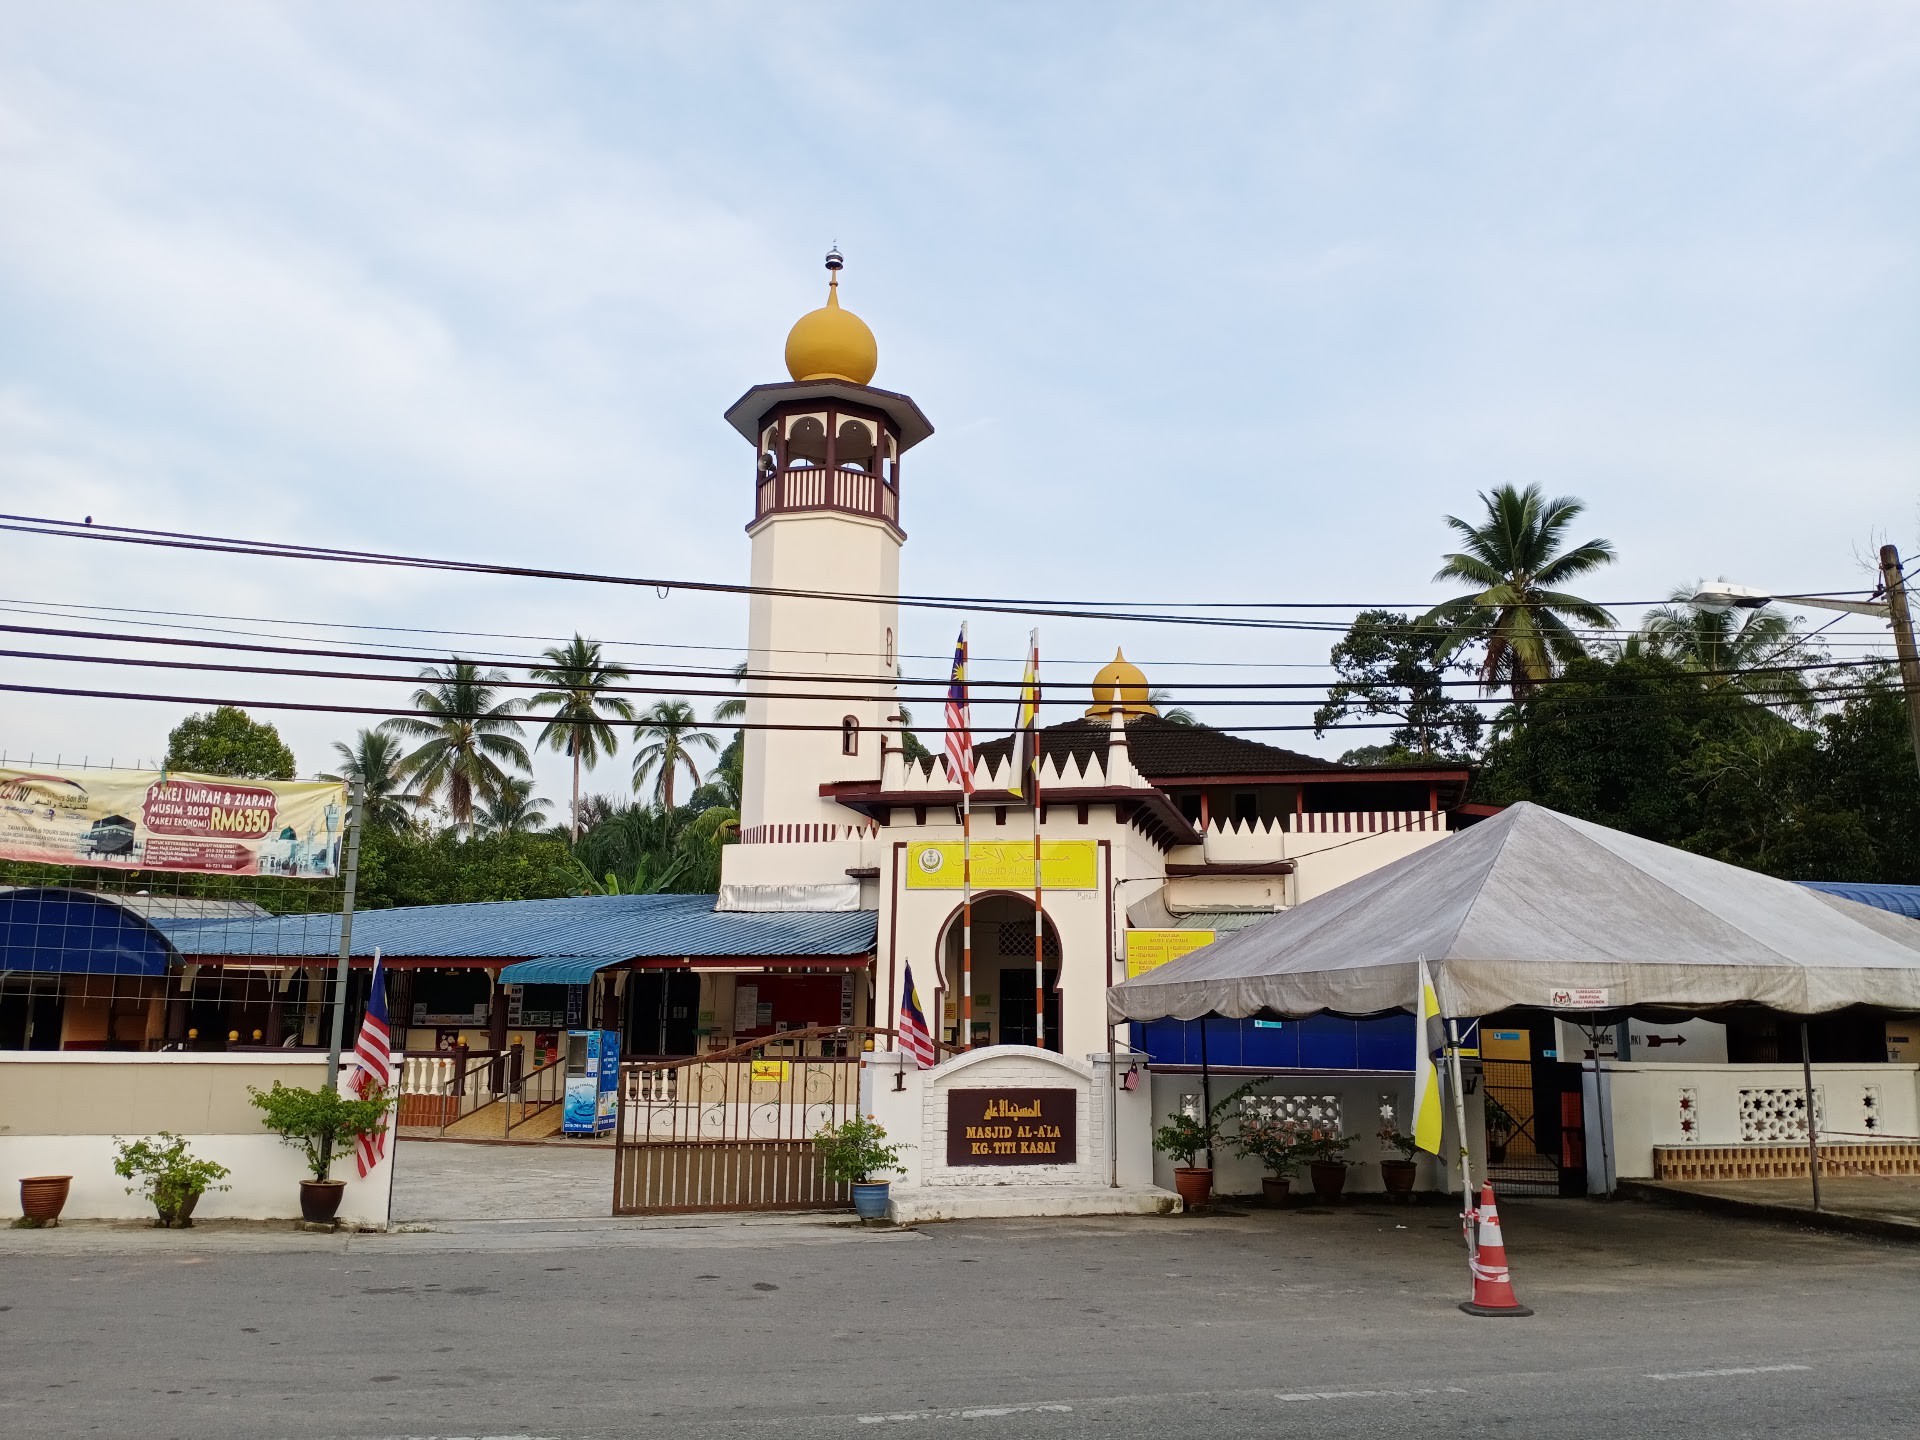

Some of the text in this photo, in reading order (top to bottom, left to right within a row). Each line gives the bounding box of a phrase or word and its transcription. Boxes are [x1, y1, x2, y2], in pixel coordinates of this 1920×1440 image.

[66, 795, 77, 803] Sdn
[77, 795, 89, 803] Bhd
[152, 786, 273, 807] PAKEJ UMRAH & ZIARAH
[149, 803, 210, 817] MUSIM 2020
[147, 815, 211, 830] (PAKEJ EKONOMI)
[210, 807, 270, 833] RM6350
[974, 867, 1007, 876] MASJID
[1009, 867, 1020, 876] AL
[966, 1126, 1012, 1139] MASJID
[971, 1141, 1056, 1155] KG. TITI KASAI
